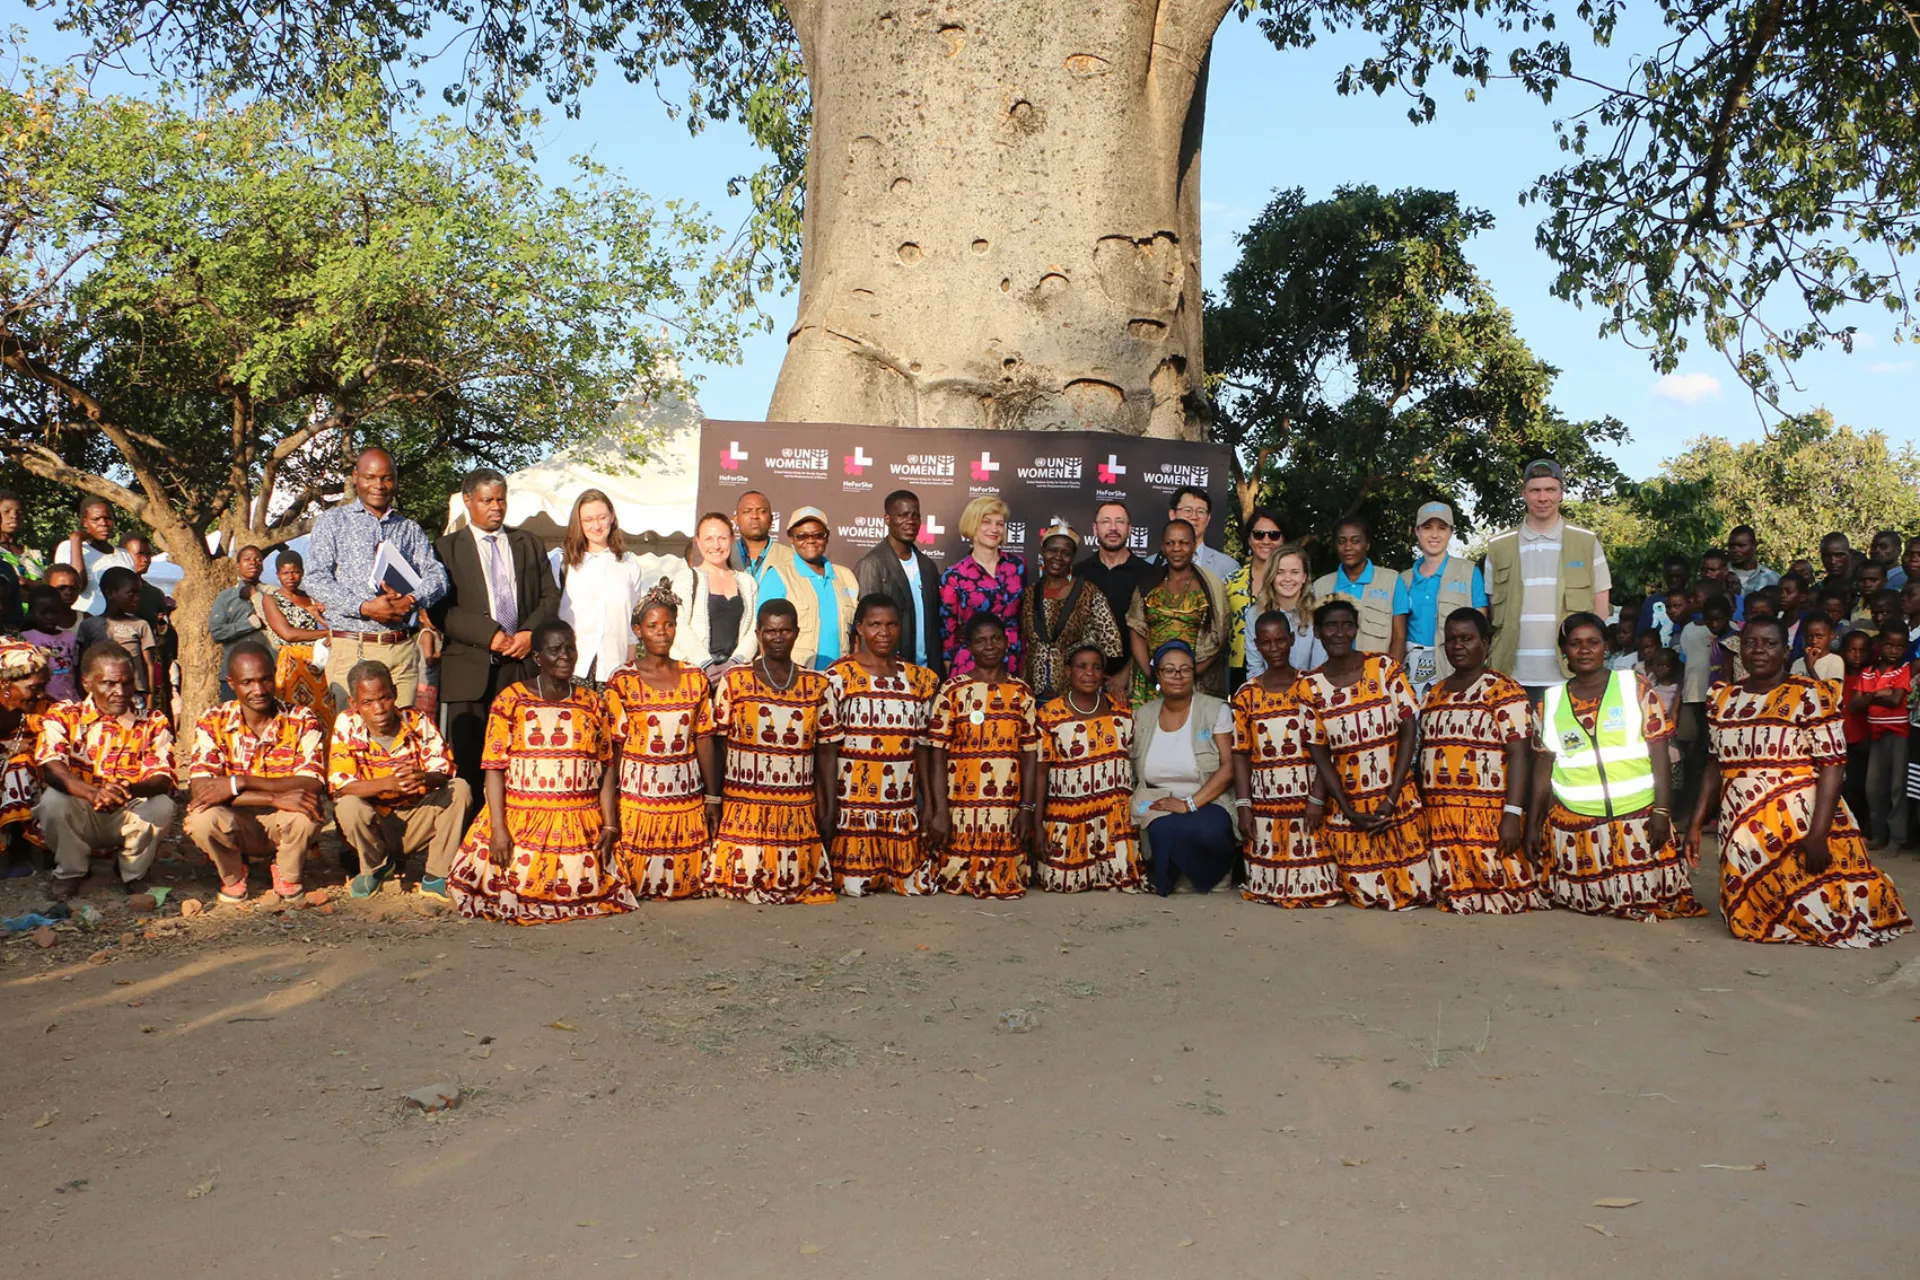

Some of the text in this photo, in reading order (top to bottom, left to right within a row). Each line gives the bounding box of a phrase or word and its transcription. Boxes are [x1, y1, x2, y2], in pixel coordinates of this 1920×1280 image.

[794, 448, 811, 459] UN
[765, 457, 811, 470] WOMEN
[919, 454, 936, 465] UN
[1047, 457, 1064, 468] UN
[889, 463, 936, 476] WOMEN
[1017, 467, 1064, 479] WOMEN
[1173, 464, 1191, 475] UN
[719, 474, 749, 483] HeForShe
[1143, 472, 1190, 486] WOMEN
[842, 480, 873, 489] HeForShe
[969, 485, 1000, 493] HeForShe
[1096, 489, 1126, 498] HeForShe
[867, 517, 884, 528] UN
[837, 525, 884, 539] WOMEN
